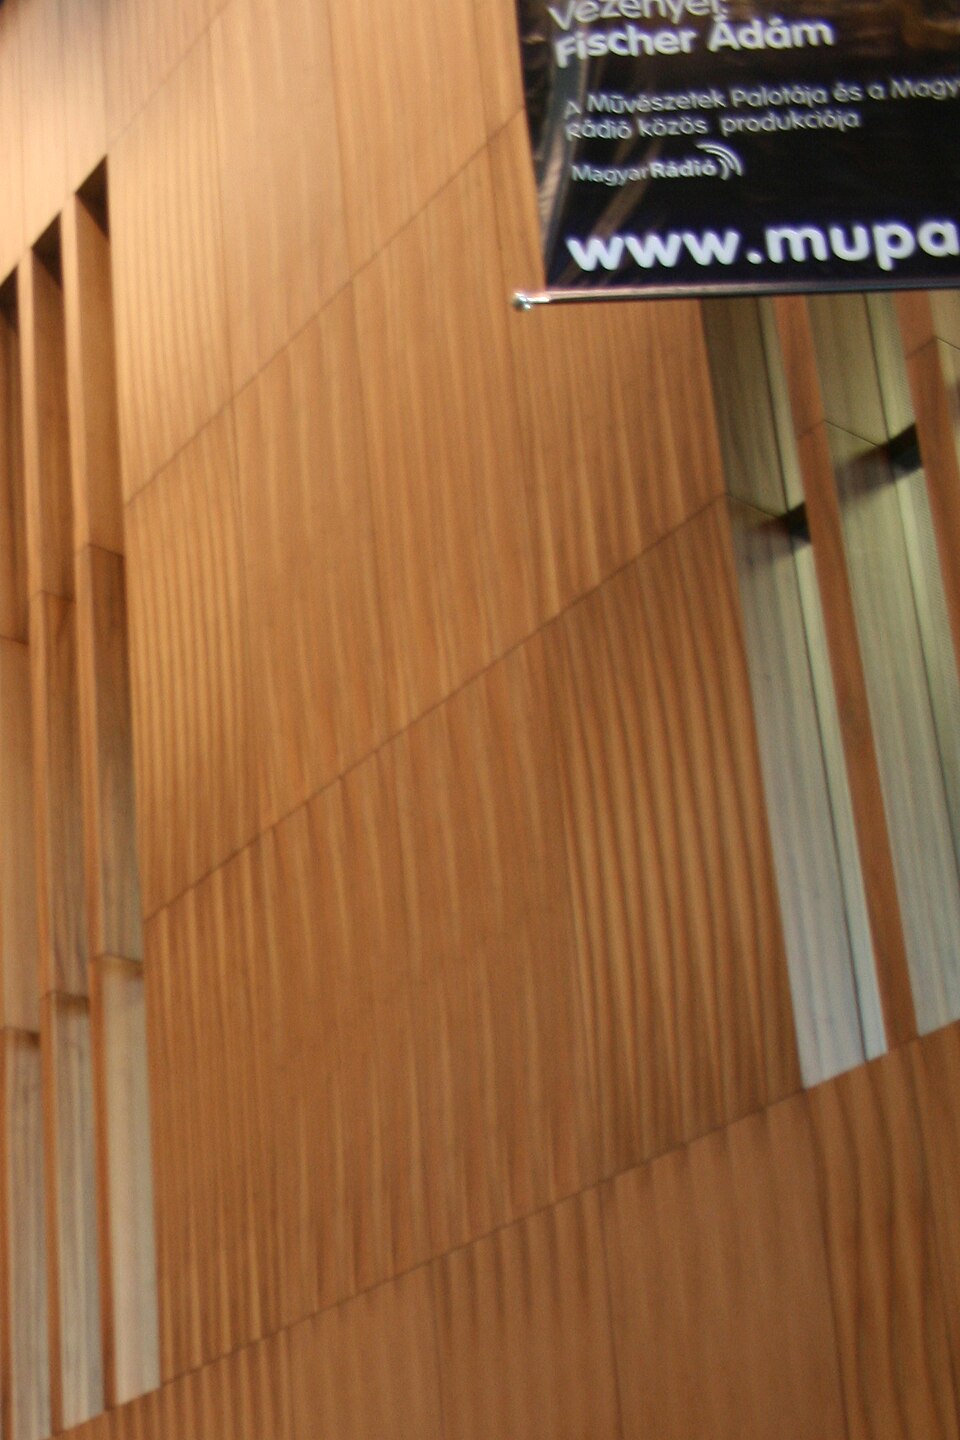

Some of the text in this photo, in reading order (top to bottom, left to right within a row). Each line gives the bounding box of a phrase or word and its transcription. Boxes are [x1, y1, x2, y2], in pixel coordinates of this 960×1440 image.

[554, 15, 835, 68] Fischer Ádám
[563, 100, 581, 120] A
[587, 87, 727, 116] Művészetek
[730, 84, 828, 109] Palotája
[833, 79, 863, 102] és
[869, 83, 886, 101] a
[566, 108, 860, 141] Rádió közös produkciója
[567, 219, 960, 272] www.mupa
